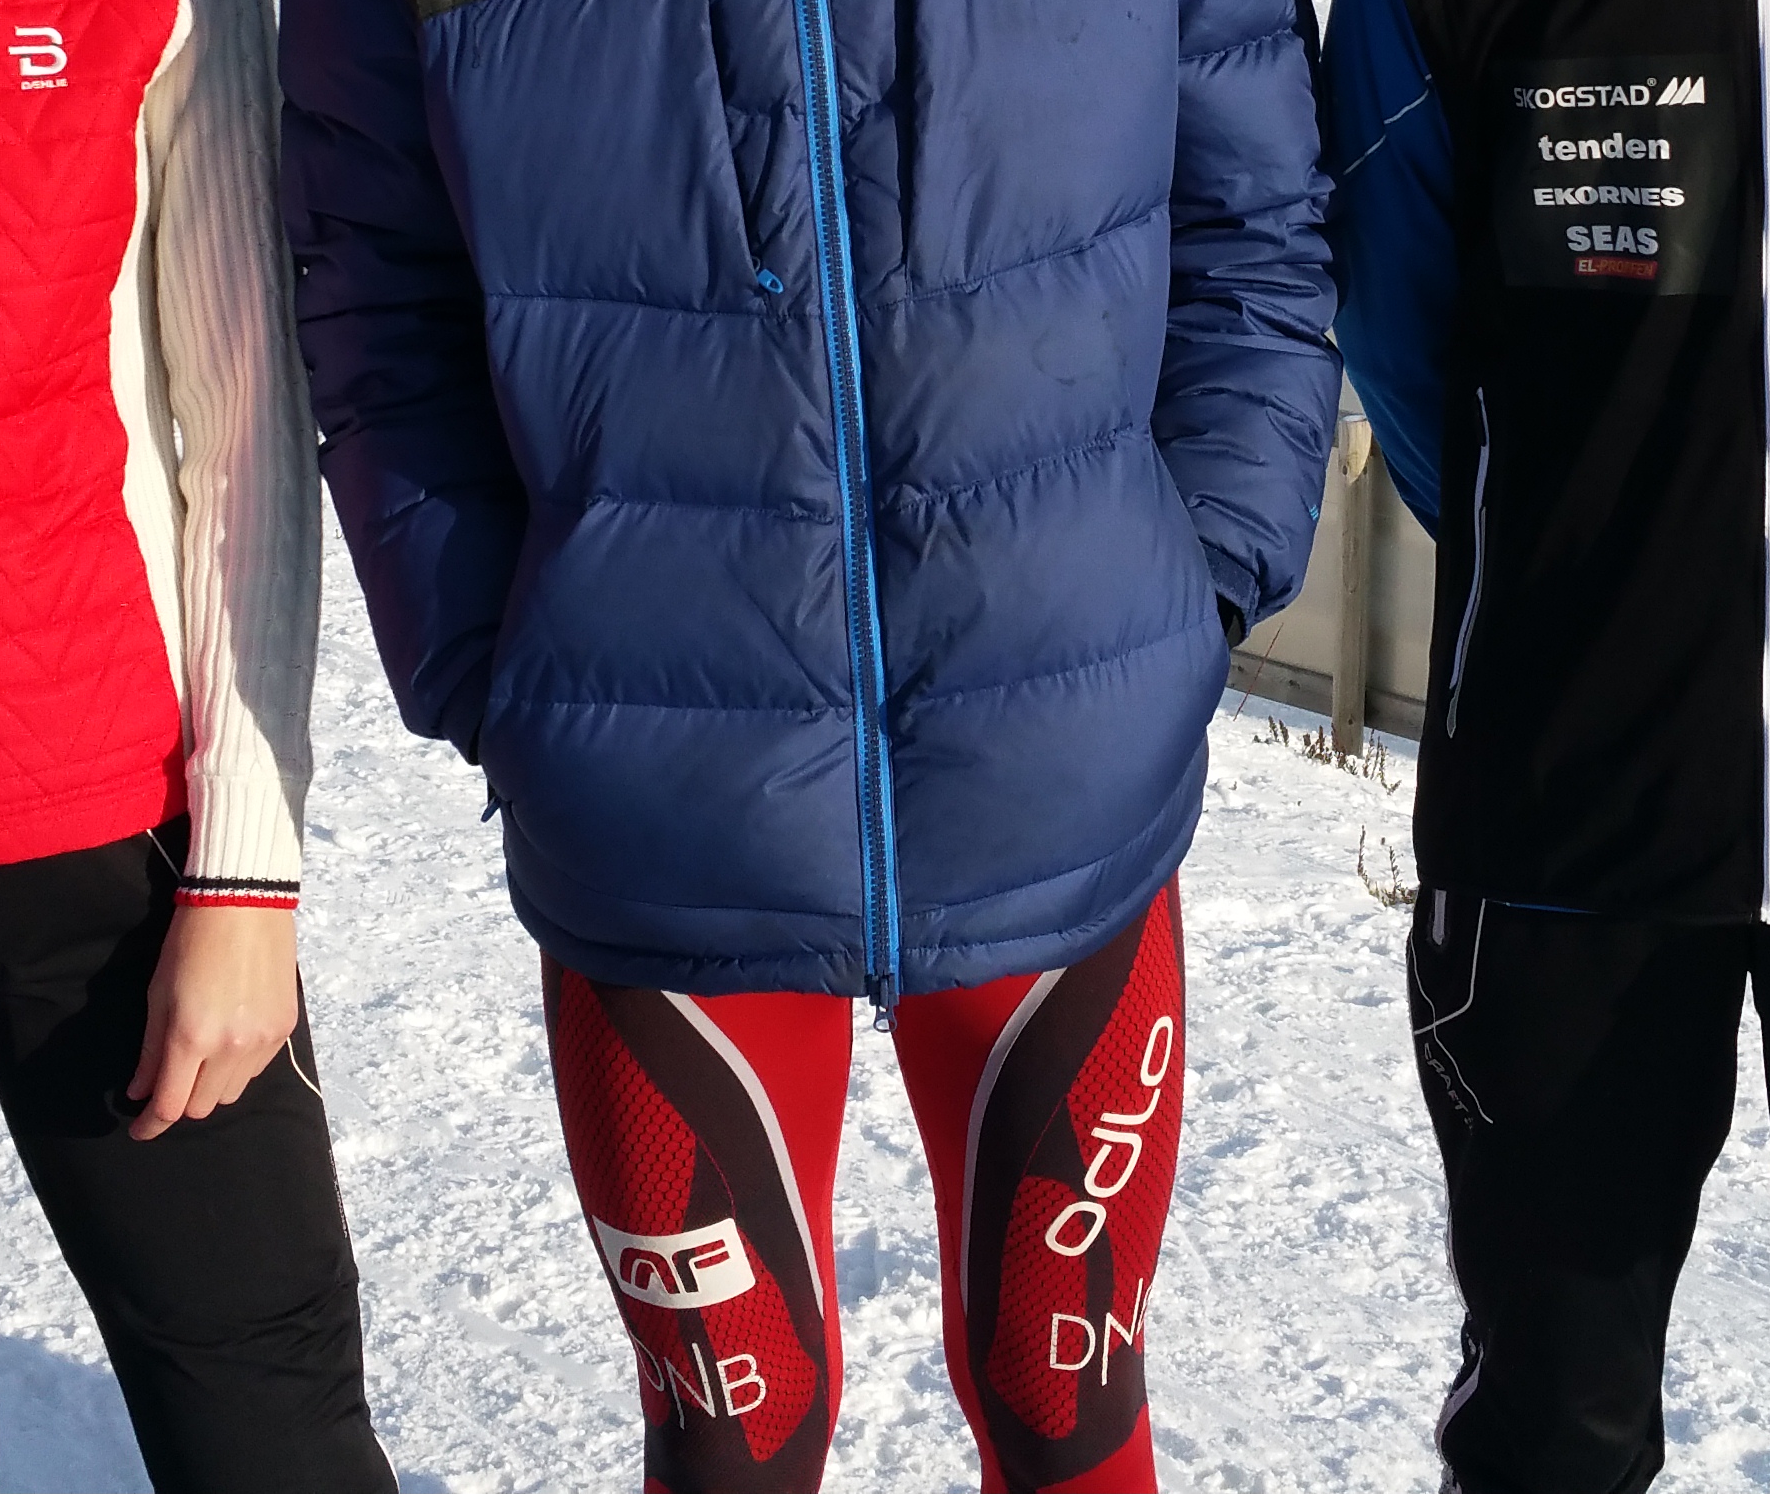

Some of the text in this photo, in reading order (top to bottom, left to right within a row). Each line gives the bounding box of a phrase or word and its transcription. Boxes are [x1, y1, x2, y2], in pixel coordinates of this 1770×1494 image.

[1514, 84, 1651, 109] SKOGSTAD
[1538, 132, 1670, 161] tenden
[1533, 185, 1685, 207] EKORNES
[1566, 225, 1659, 255] SEAS
[628, 1329, 766, 1430] DNB
